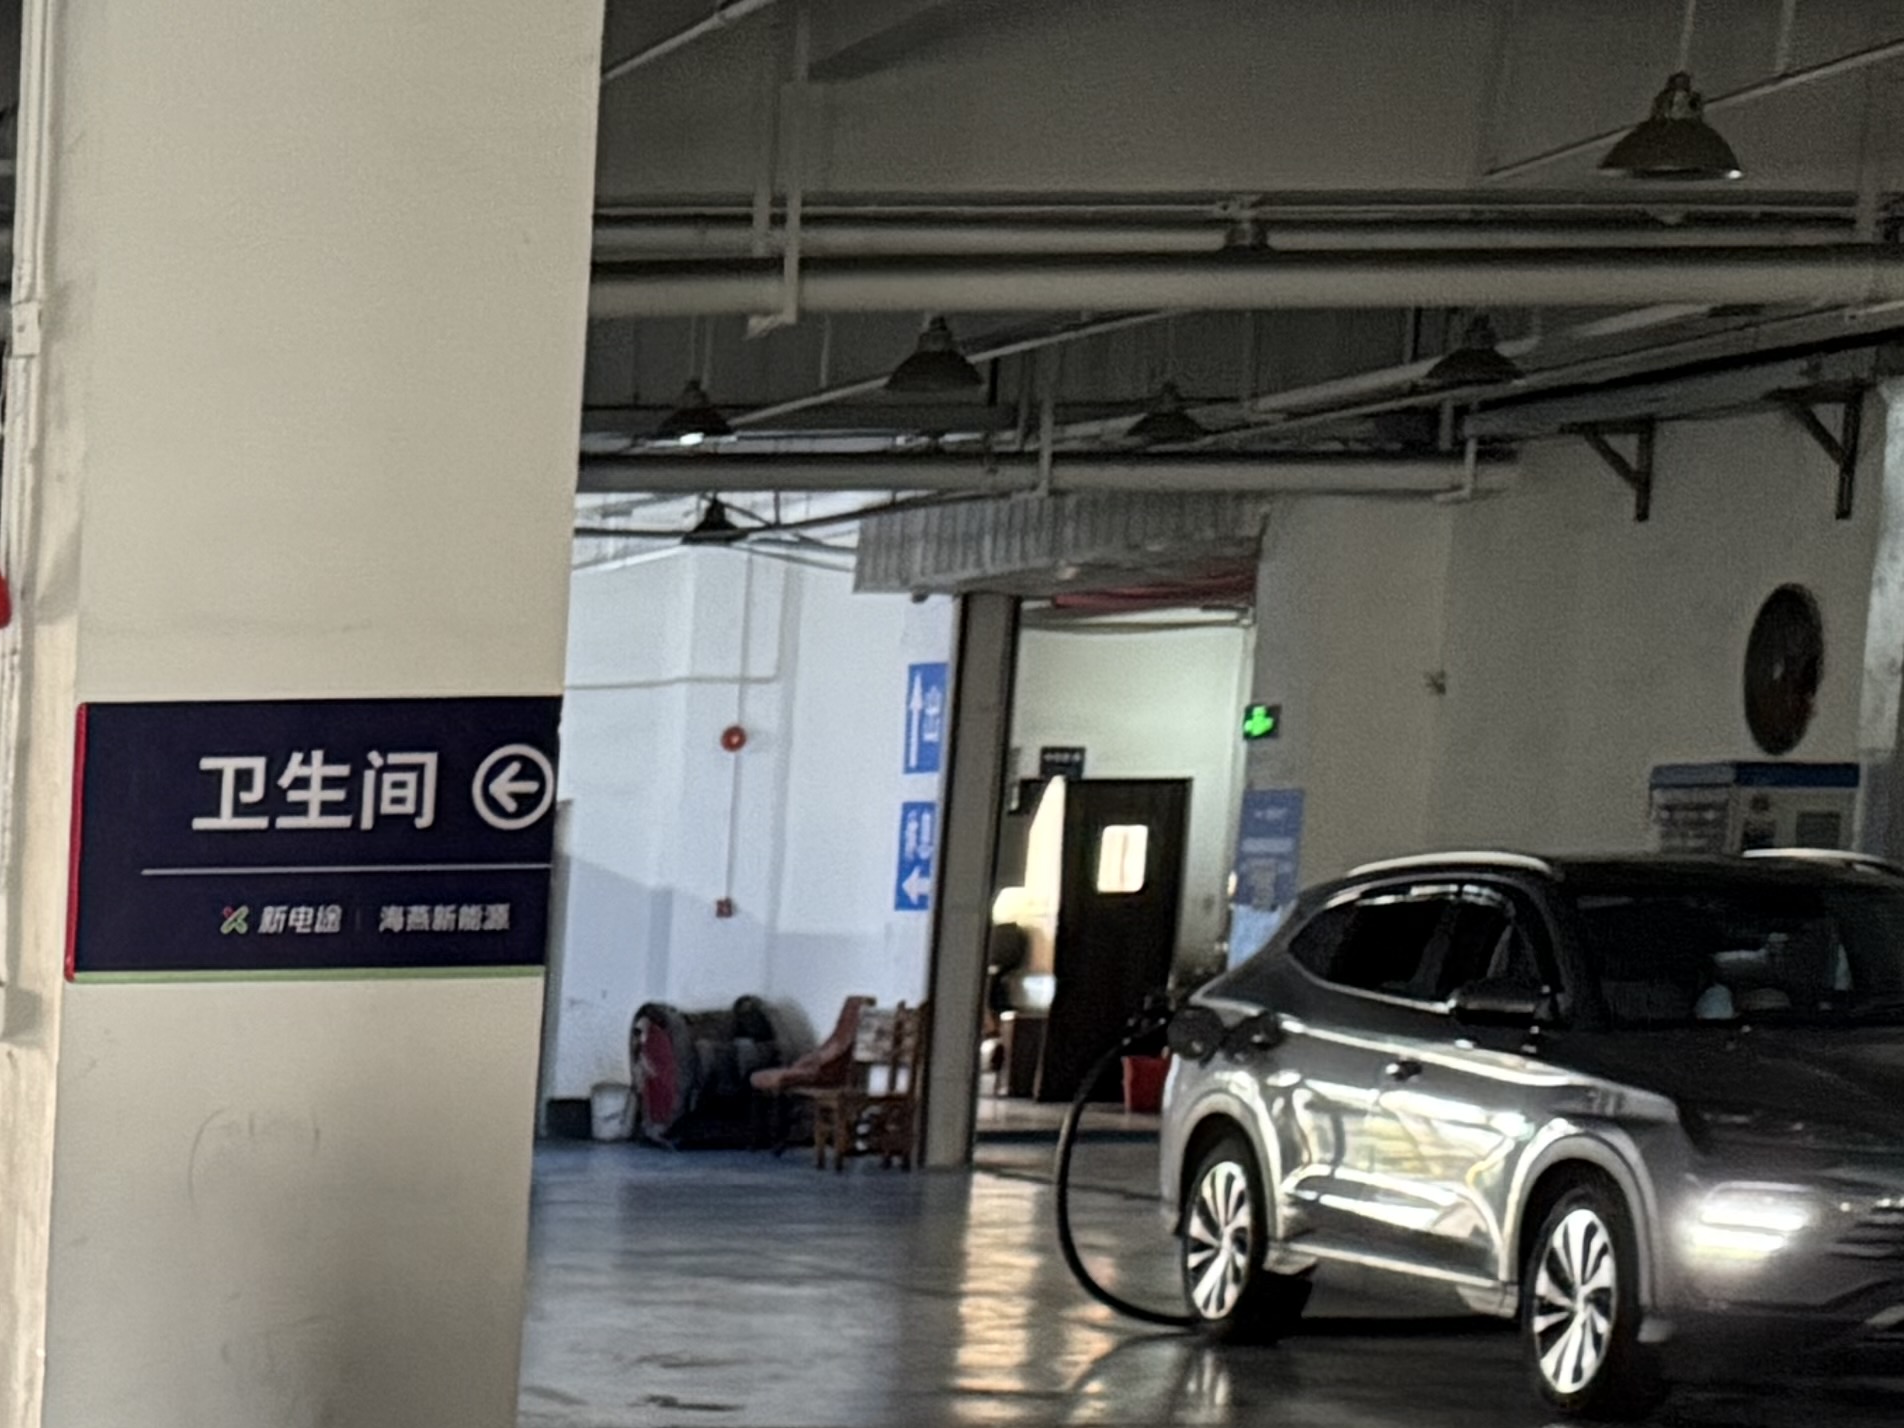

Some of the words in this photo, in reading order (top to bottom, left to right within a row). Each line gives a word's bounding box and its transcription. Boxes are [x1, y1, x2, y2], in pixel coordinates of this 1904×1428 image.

[190, 749, 440, 832] 卫生间
[257, 904, 343, 934] 新电途
[379, 903, 511, 933] 海燕新能源
